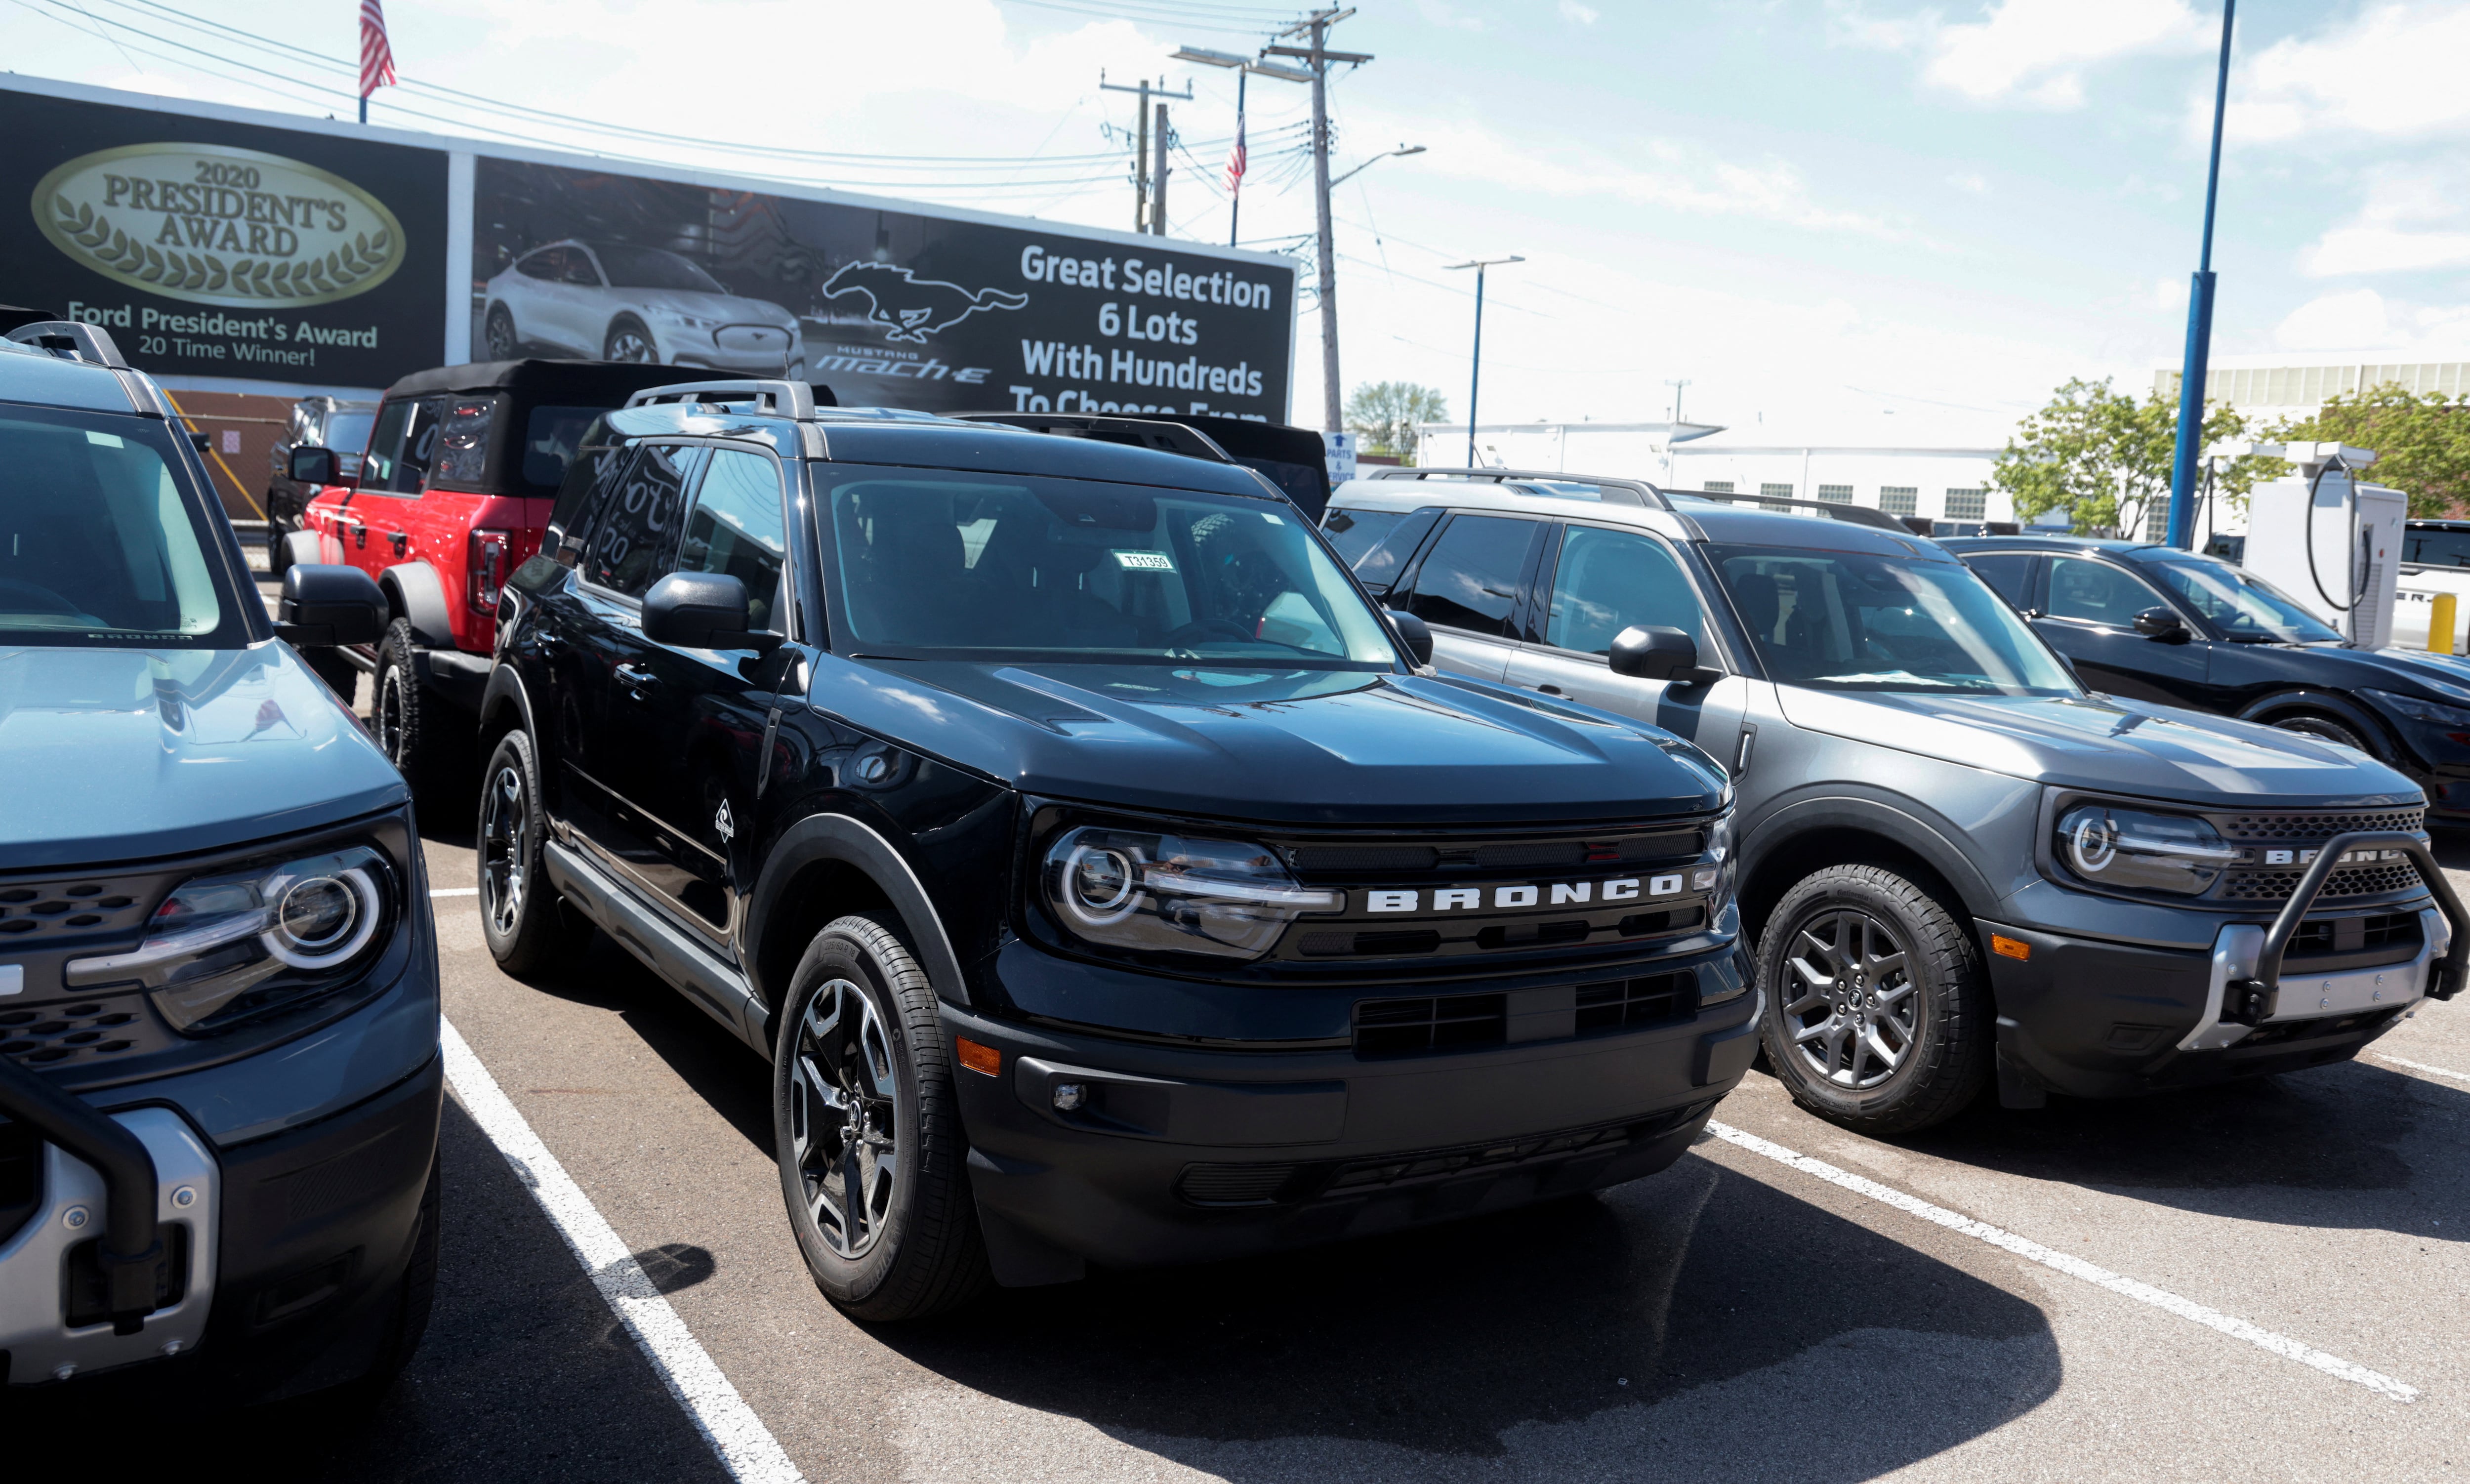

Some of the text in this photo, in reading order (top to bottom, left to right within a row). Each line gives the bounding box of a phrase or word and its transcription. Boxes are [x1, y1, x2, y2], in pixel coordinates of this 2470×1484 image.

[194, 161, 260, 190] 2020
[104, 173, 347, 232] PRESIDENT'S
[155, 216, 299, 257] AWARD
[1021, 245, 1271, 310] Great Selection
[68, 301, 378, 349] Ford President's Award
[1099, 303, 1198, 345] 6 Lots
[139, 336, 315, 367] 20 Time Winner!
[837, 346, 918, 360] MUSTANG
[1022, 340, 1262, 396] With Hundreds
[1327, 449, 1351, 459] PARTS
[1328, 471, 1355, 481] ERVICE
[1125, 556, 1168, 567] T31359
[1367, 874, 1683, 912] BRONCO
[849, 948, 856, 957] 18
